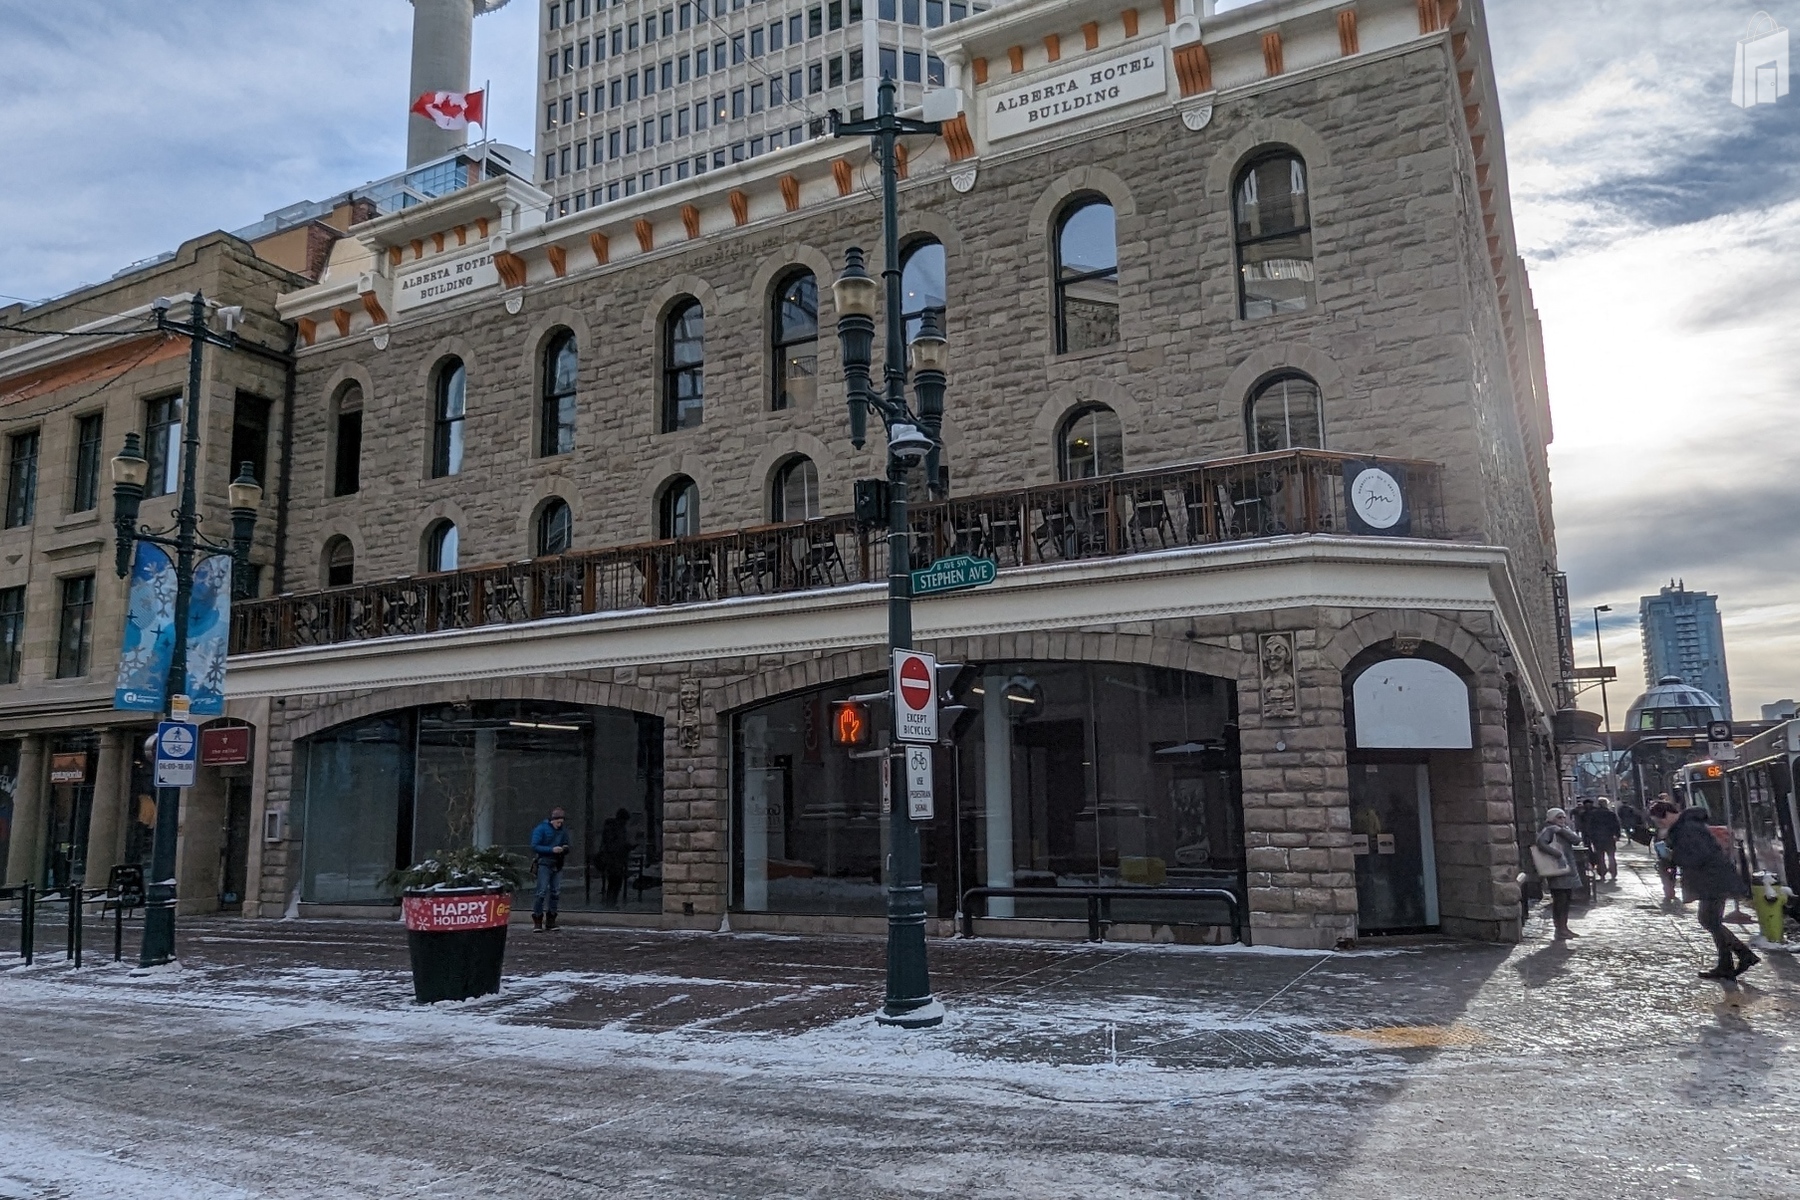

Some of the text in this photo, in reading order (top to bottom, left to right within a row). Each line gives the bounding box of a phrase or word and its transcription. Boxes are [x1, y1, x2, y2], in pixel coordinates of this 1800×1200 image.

[995, 56, 1155, 114] ALBERTA HOTEL
[1028, 86, 1121, 123] BUILDING
[402, 255, 493, 290] ALBERTA HOTEL
[420, 276, 473, 299] BUILDING
[943, 561, 955, 570] AVE
[957, 560, 968, 568] SW
[920, 565, 988, 589] STEPHEN AVE
[906, 713, 928, 724] EXCEPT
[904, 725, 932, 736] BICYCLES
[432, 901, 488, 916] HAPPY
[433, 914, 487, 926] HOLIDAYS
